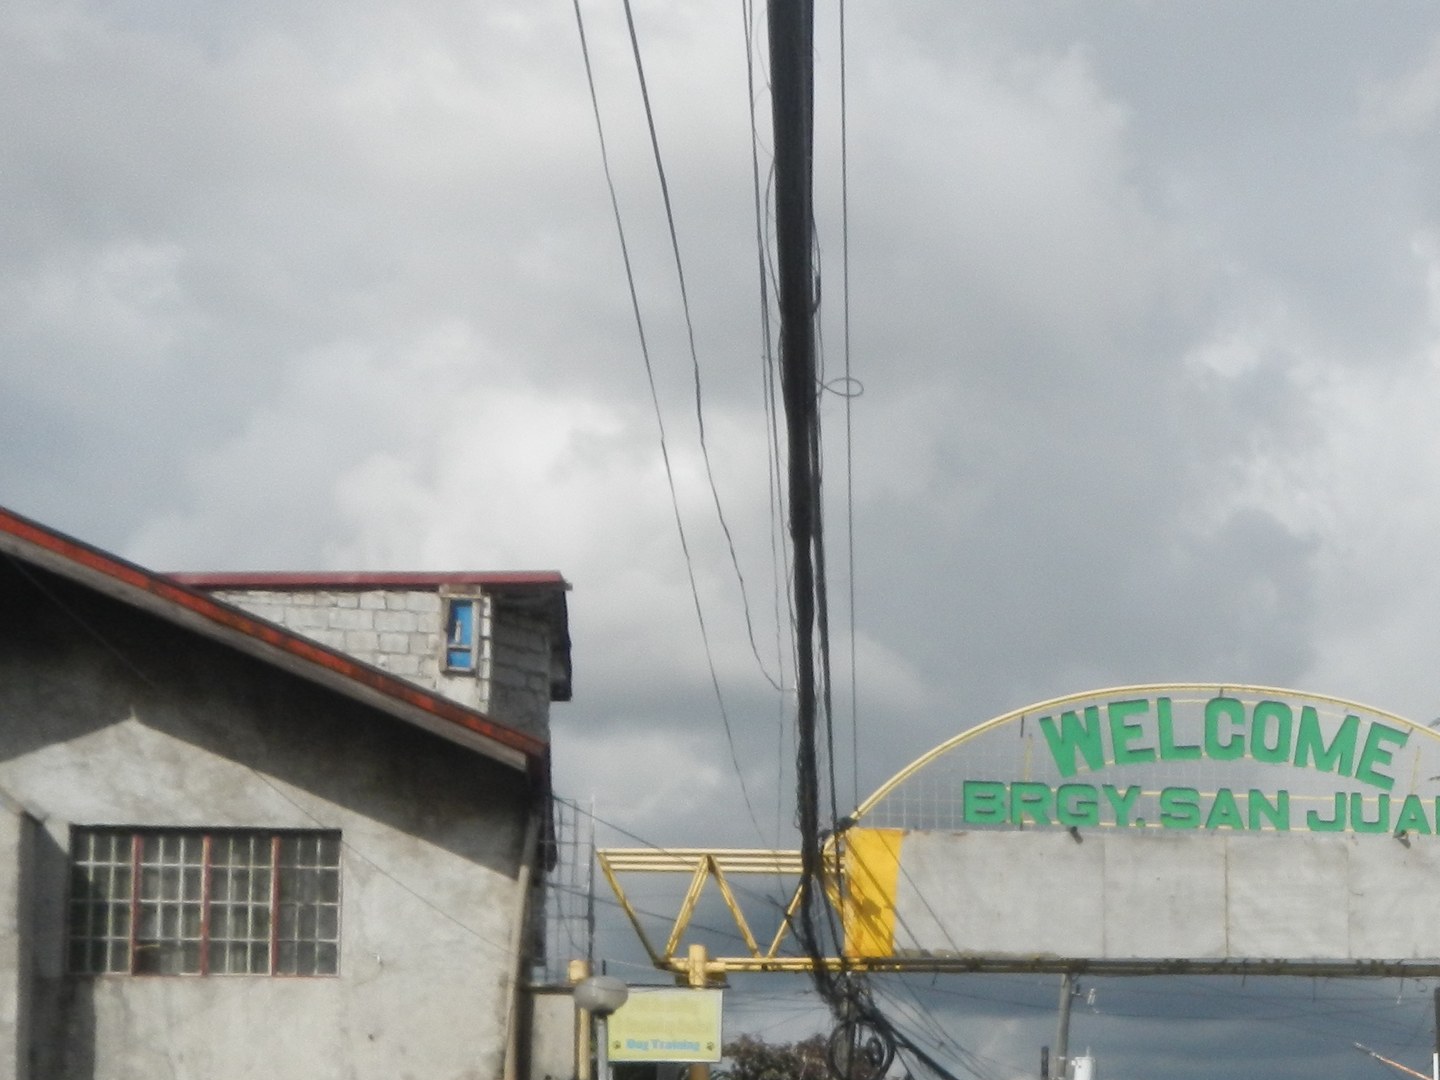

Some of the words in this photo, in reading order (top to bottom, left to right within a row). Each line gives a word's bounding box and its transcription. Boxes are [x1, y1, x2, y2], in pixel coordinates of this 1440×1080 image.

[1038, 697, 1409, 790] WELCOME
[962, 780, 1145, 828] BRGY.
[1159, 786, 1290, 831] SAN
